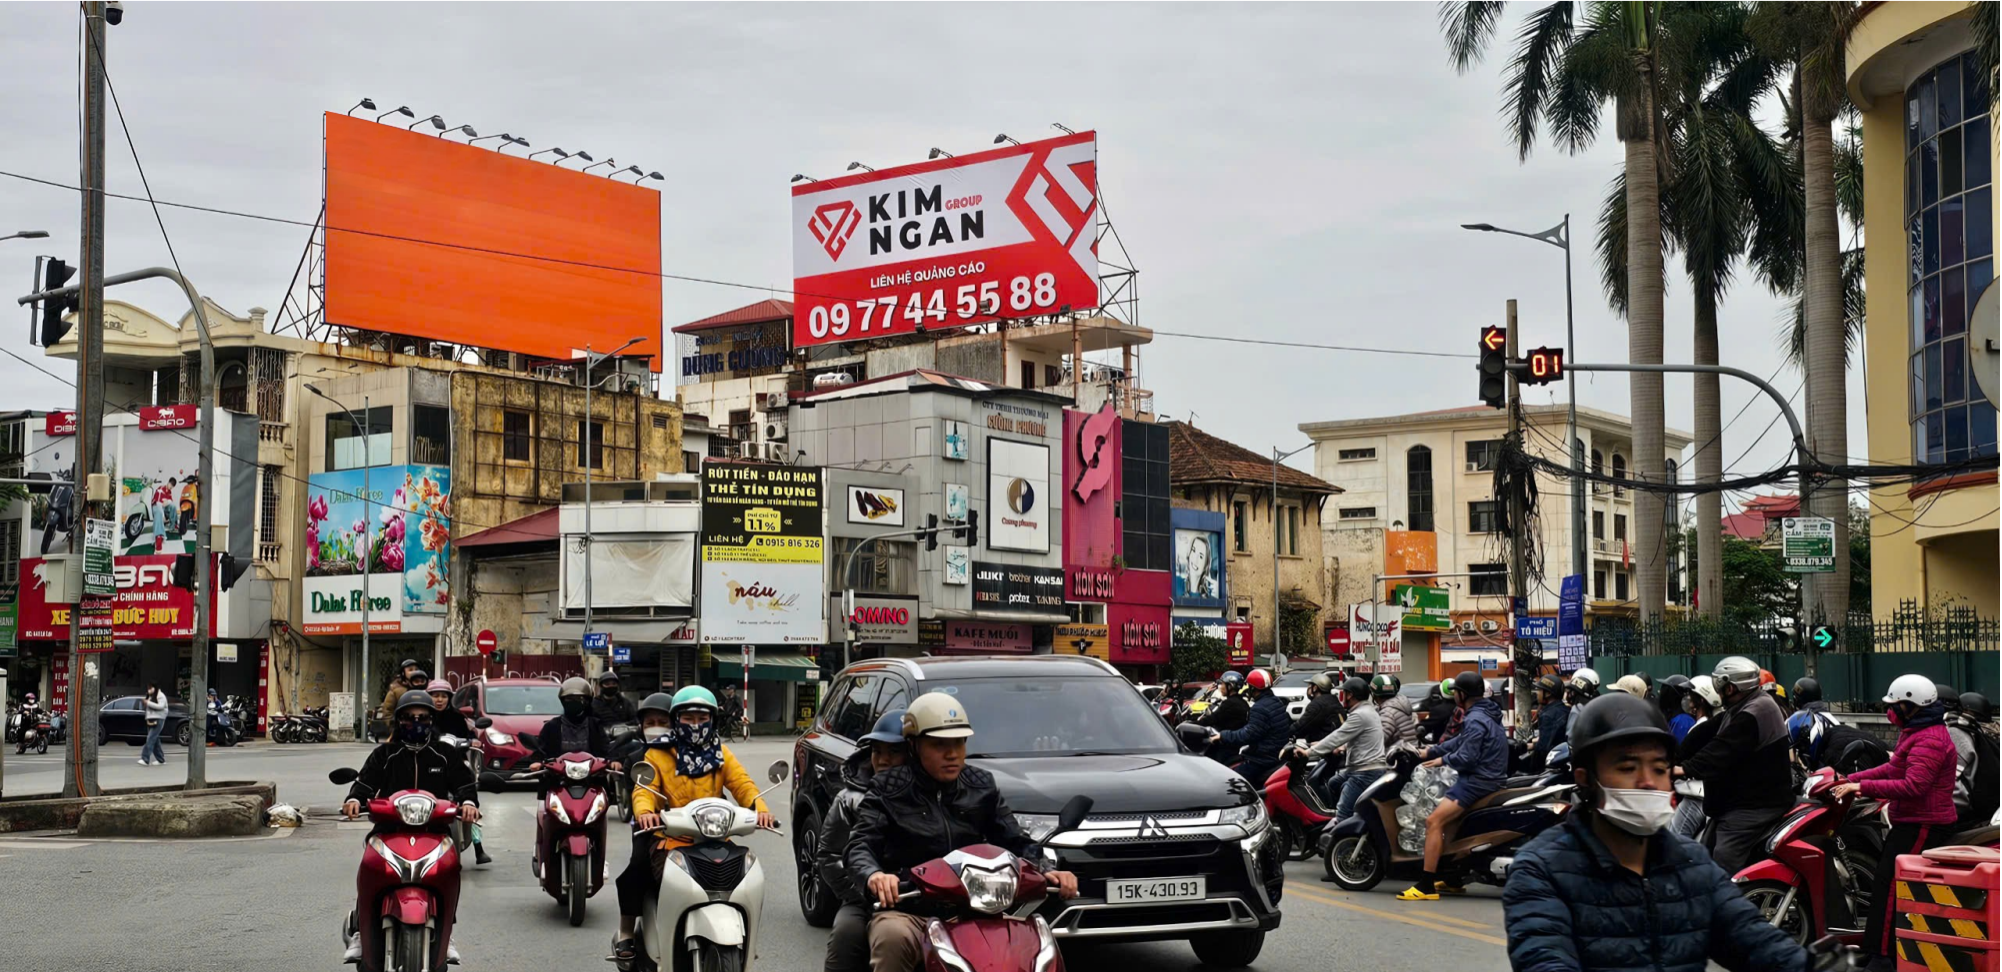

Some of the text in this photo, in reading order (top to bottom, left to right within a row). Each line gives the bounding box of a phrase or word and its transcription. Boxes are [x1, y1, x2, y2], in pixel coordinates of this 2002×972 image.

[869, 184, 983, 223] KIM GROUP
[870, 210, 984, 255] NGAN
[870, 261, 986, 289] LIÊN HỆ QUẢNG CÁO
[809, 272, 1057, 338] 09 77 44 55 88
[1532, 355, 1558, 376] 01
[708, 466, 730, 479] RÚT
[732, 467, 758, 480] TIỀN
[768, 469, 790, 482] ĐÁO
[793, 472, 816, 484] HẠN
[709, 482, 816, 499] THẺ TÍN DỤNG
[709, 535, 730, 543] LIÊN
[766, 539, 785, 547] 0915
[805, 540, 821, 549] 326
[977, 571, 1063, 586] JUKI brother KANSAI
[1073, 567, 1094, 597] NÓN
[735, 581, 777, 598] nâu
[311, 591, 347, 613] Dalat
[51, 609, 70, 625] XE
[113, 605, 145, 625] ĐỨC
[149, 608, 180, 625] HUY
[842, 606, 909, 624] OMINO
[955, 628, 985, 639] KAFE
[1122, 619, 1141, 647] NÓN
[1534, 626, 1552, 637] HIỆU
[1117, 881, 1198, 899] 15K-430.93
